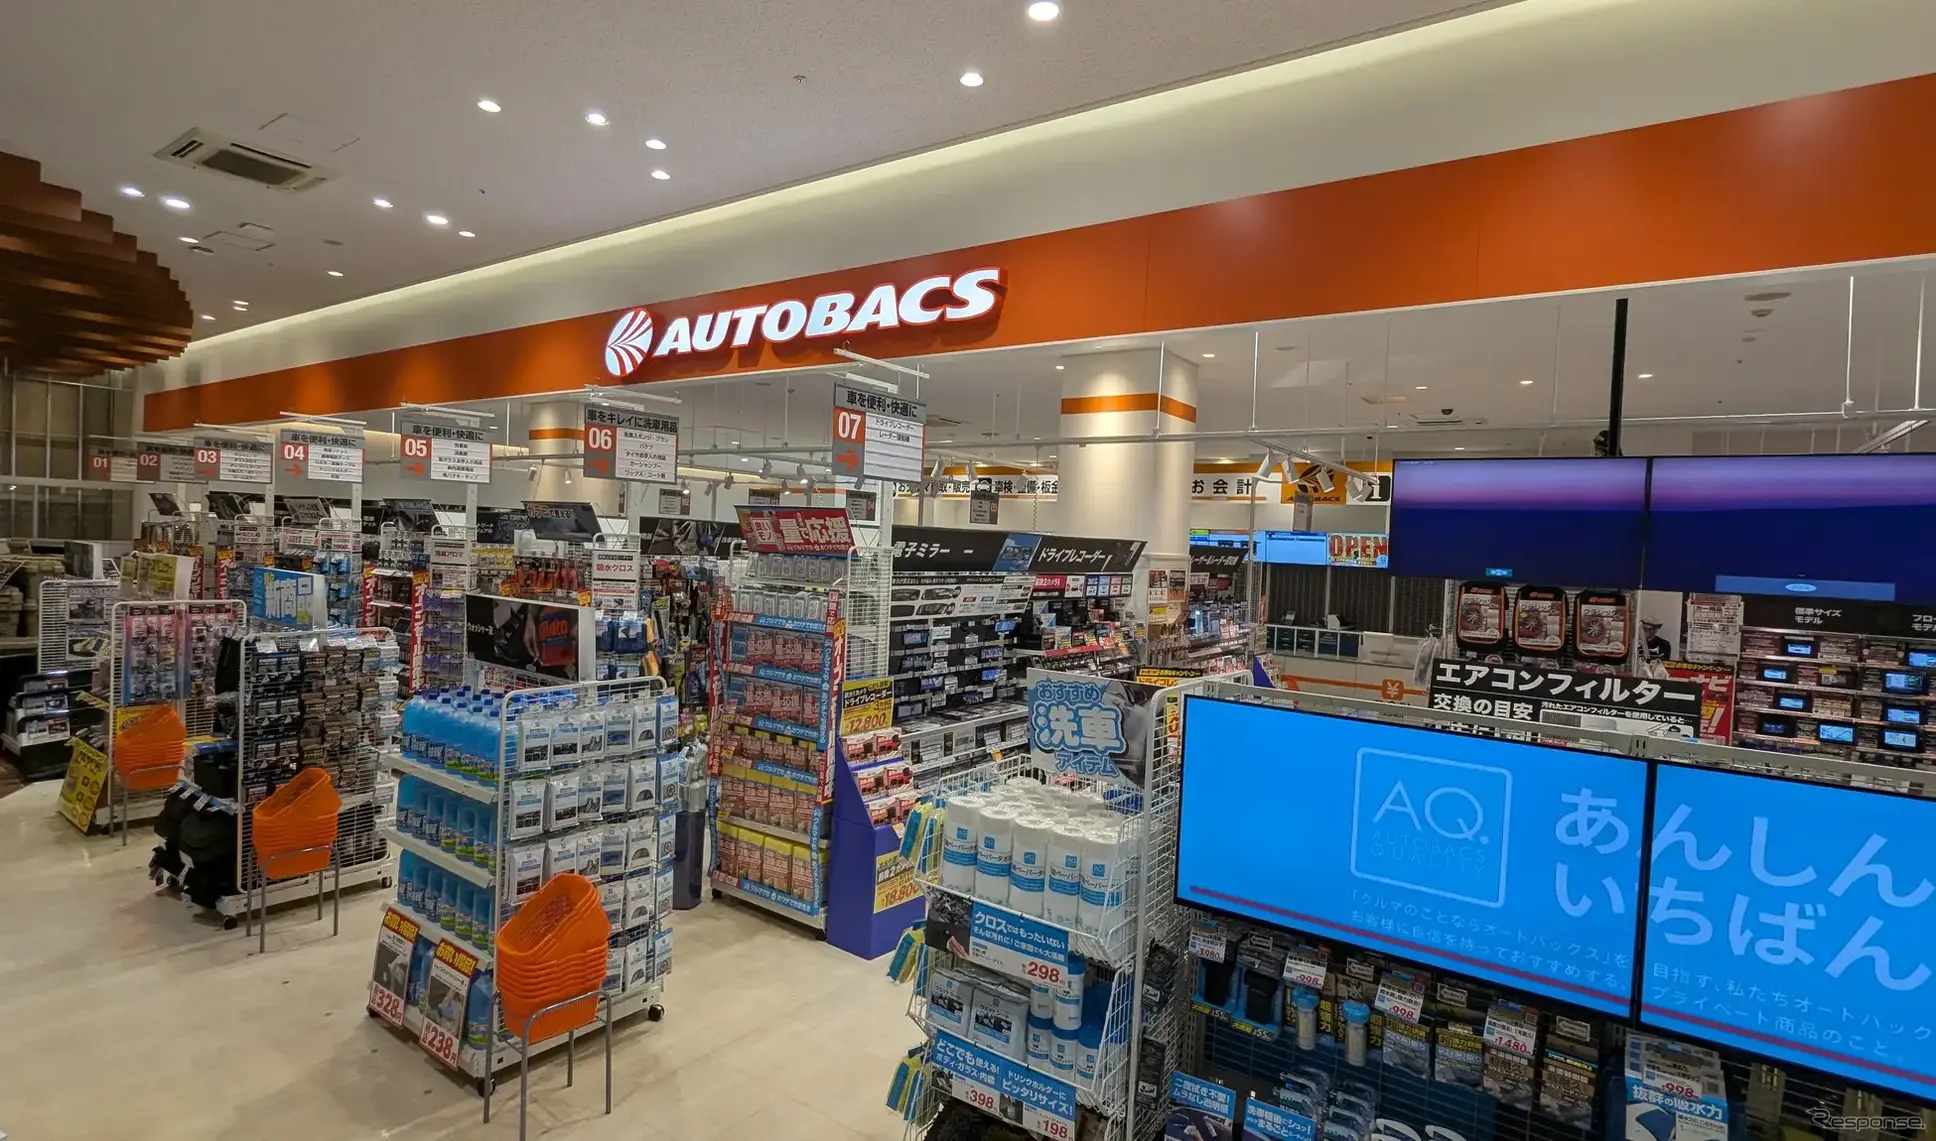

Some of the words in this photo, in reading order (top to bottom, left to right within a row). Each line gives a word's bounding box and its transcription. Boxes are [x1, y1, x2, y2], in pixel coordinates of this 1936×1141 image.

[653, 268, 1000, 356] AUTOBACS
[846, 390, 917, 418] 車を便利・快適に
[413, 425, 484, 441] 車を便利・快適に
[588, 409, 678, 433] 車をキレイに洗車用品
[838, 411, 862, 440] 07
[291, 434, 356, 447] 車を便利・快適に
[405, 438, 427, 457] 05
[589, 427, 612, 450] 06
[93, 457, 108, 468] 01
[140, 454, 158, 466] 02
[198, 450, 217, 463] 03
[284, 445, 305, 460] 04
[1038, 547, 1107, 564] ドライブレコーダー
[1329, 535, 1387, 558] OPEN
[597, 564, 634, 573] 吸水クロス
[1795, 607, 1842, 617] 標準サイズ
[1795, 616, 1823, 625] モデル
[1037, 680, 1101, 701] おすすめ
[1436, 663, 1696, 705] エアコンフィルター
[844, 690, 892, 707] ドライブレコーダー
[1433, 692, 1534, 721] 交換の目安
[1037, 704, 1123, 748] 洗車
[1056, 752, 1119, 777] アイテム
[1371, 830, 1487, 863] AUTOBACS
[1555, 787, 1934, 909] あんしん
[1369, 844, 1486, 876] QUALITY
[384, 911, 418, 942] お買い得品!
[974, 911, 1065, 949] クロスではもったいない
[1554, 861, 1933, 992] いちばん
[436, 943, 476, 976] お買い得品!
[936, 1038, 1000, 1074] どこでも使える!
[1002, 1079, 1073, 1116] ピッタリサイズ!
[1008, 1070, 1067, 1101] ドリンクホルダーに
[1173, 1078, 1231, 1104] 二度拭き不要!
[1633, 1085, 1722, 1120] 抜群の吸水力
